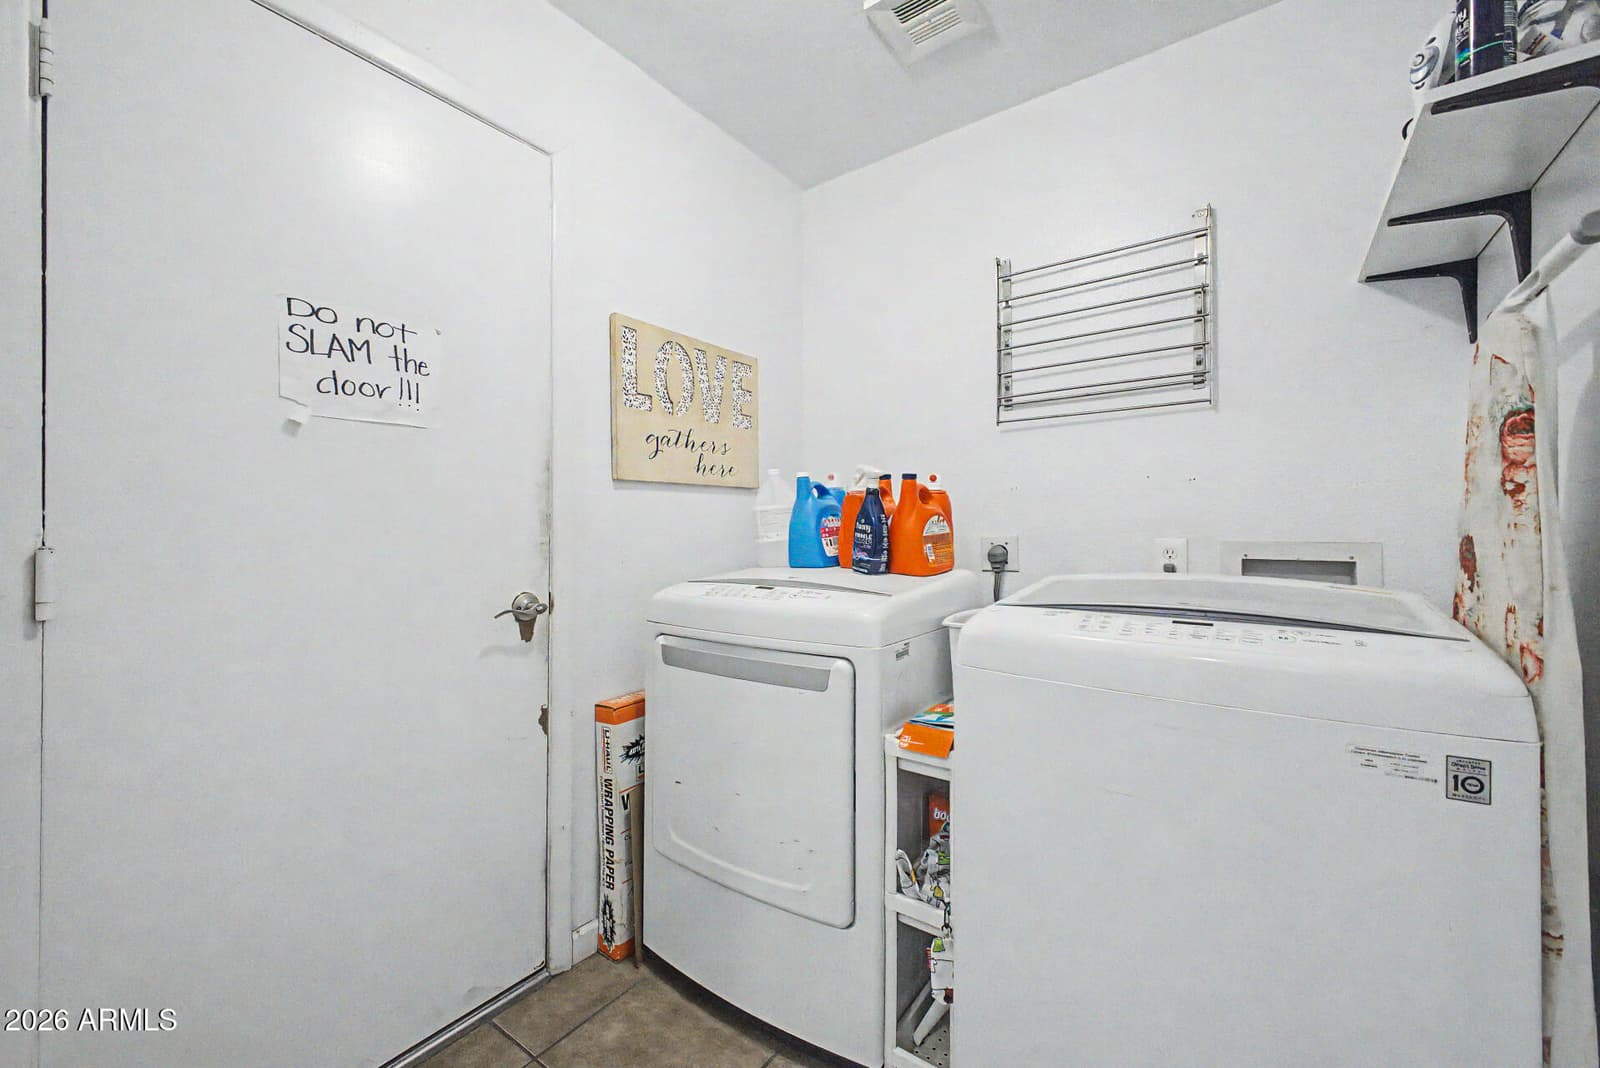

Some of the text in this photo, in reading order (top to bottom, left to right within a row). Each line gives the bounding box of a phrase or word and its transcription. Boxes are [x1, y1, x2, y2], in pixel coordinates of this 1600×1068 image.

[286, 297, 418, 344] Do not
[286, 323, 430, 377] SLAM the
[621, 325, 753, 430] LOVE
[645, 428, 732, 460] gathers
[695, 453, 737, 478] here
[604, 728, 612, 770] U-HAUL
[1453, 774, 1484, 795] 10
[604, 778, 615, 846] WRAPPING
[606, 849, 616, 891] PAPER
